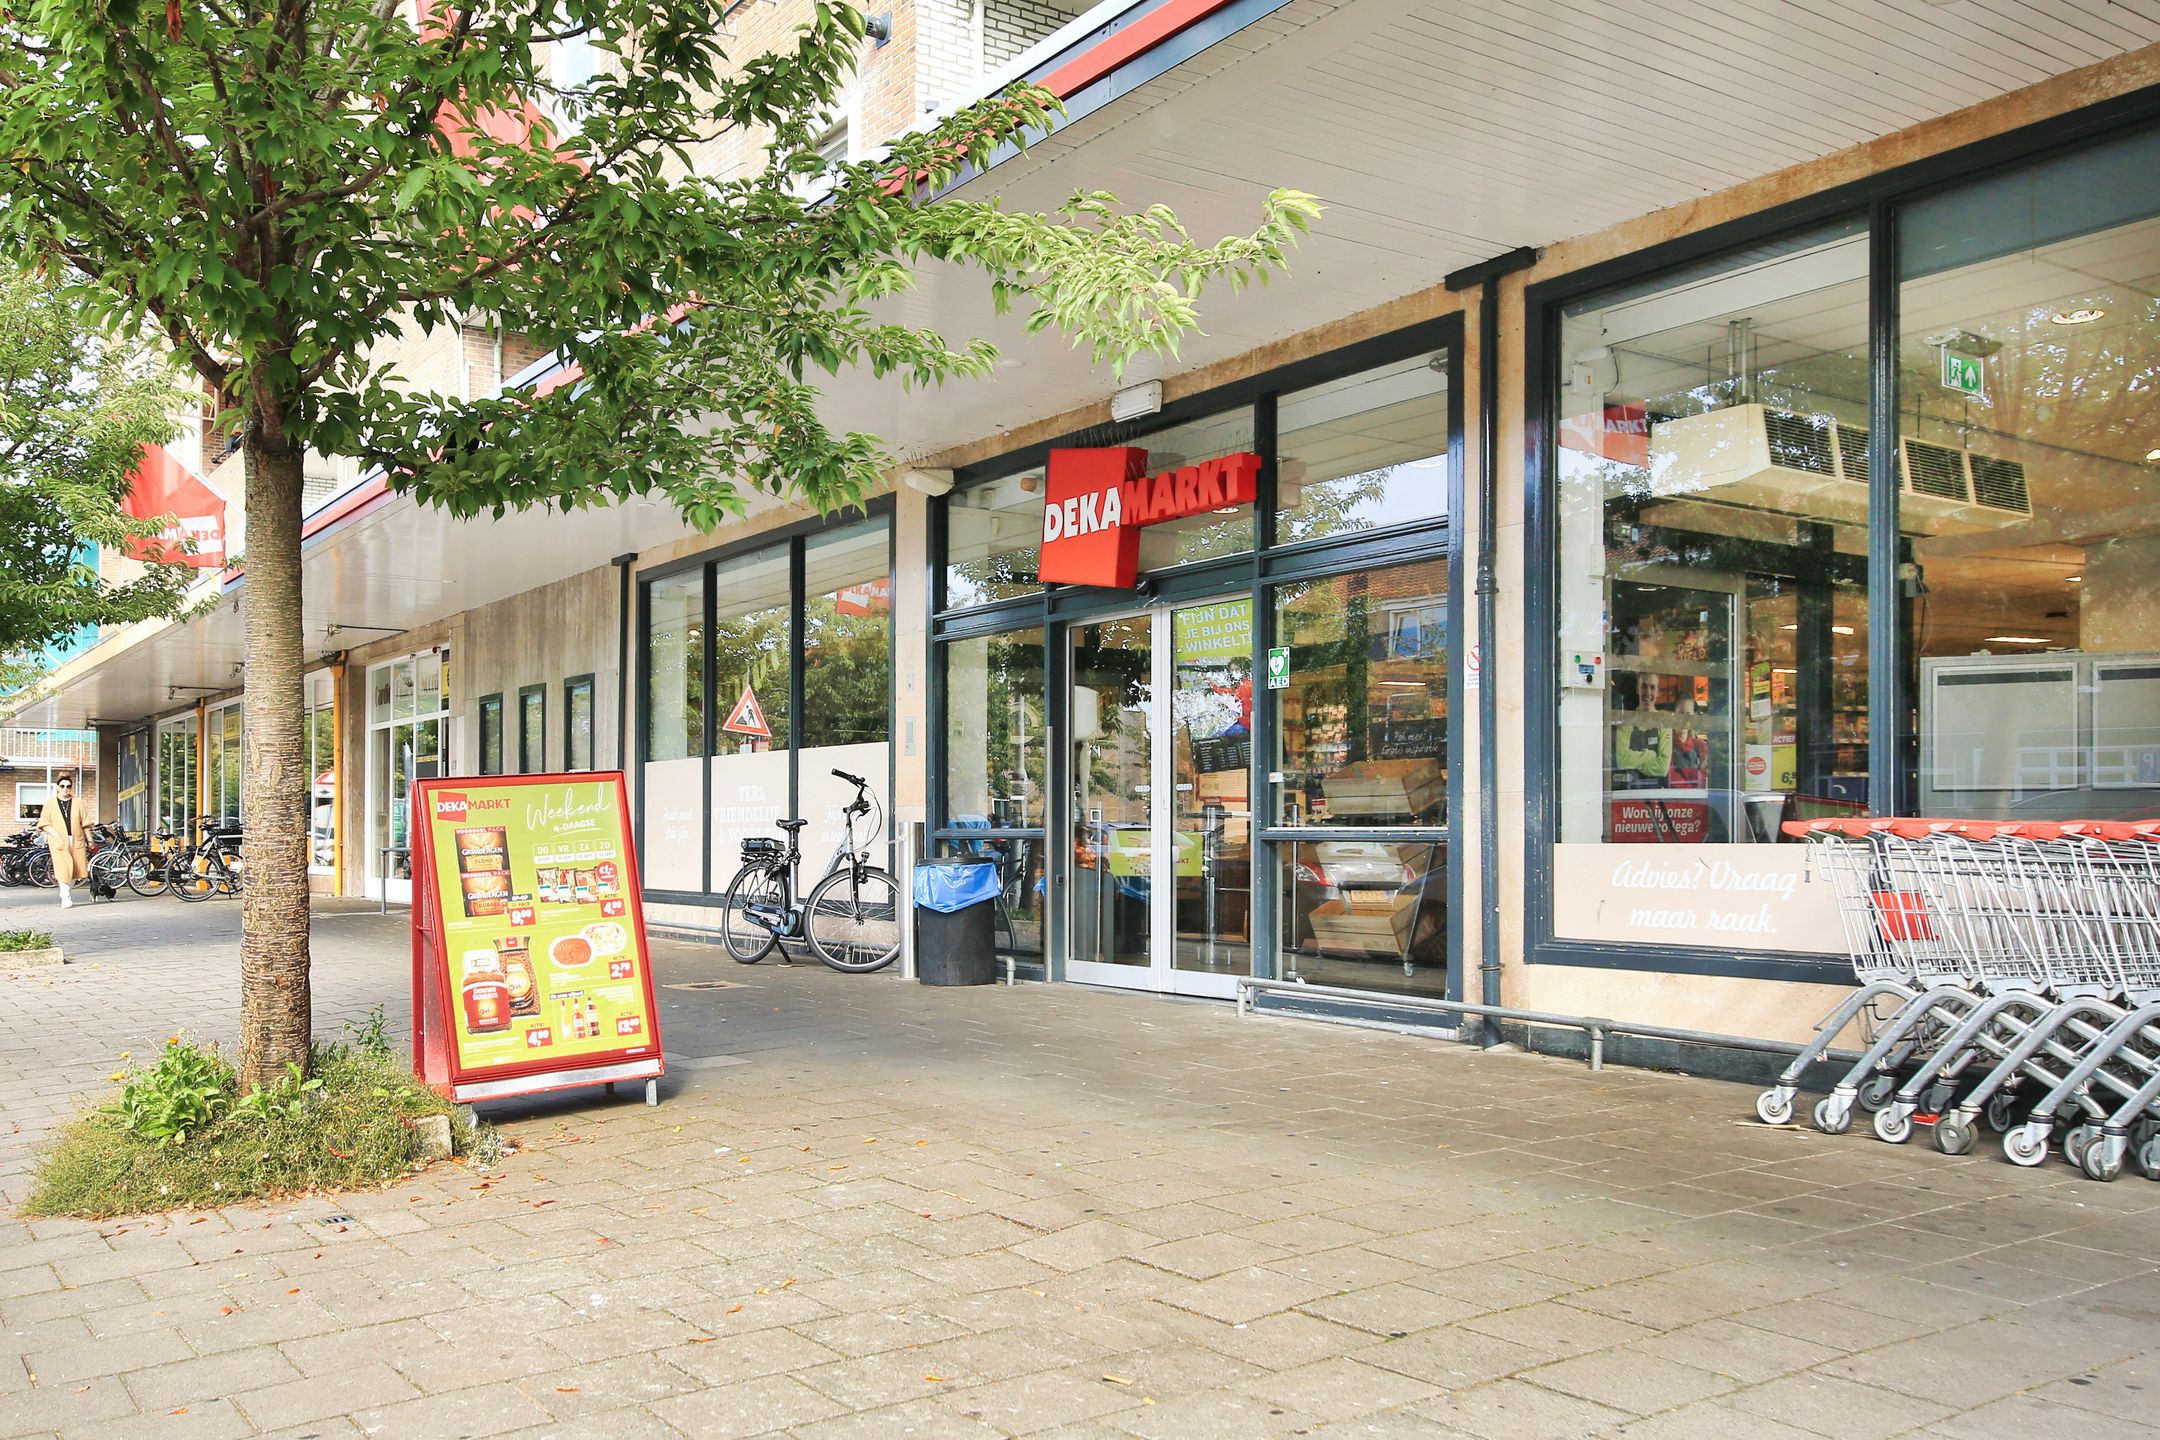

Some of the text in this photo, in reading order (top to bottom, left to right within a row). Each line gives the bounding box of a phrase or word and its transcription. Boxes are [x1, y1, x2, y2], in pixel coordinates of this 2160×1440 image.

[1043, 452, 1261, 543] DEKAMARKT
[1182, 604, 1246, 626] FIJN DAT
[1184, 620, 1250, 640] JE BIJ ONS
[1269, 677, 1289, 687] AED
[437, 798, 511, 813] DEKAMARKT
[526, 782, 612, 831] Weekend
[1667, 807, 1694, 818] onze
[553, 818, 597, 833] 4-DAAGSE
[1614, 819, 1654, 833] nieuwe
[558, 844, 569, 852] VR
[578, 843, 590, 851] ZA
[1611, 859, 1798, 901] Advies? Vraag
[1628, 903, 1777, 934] maar raak.
